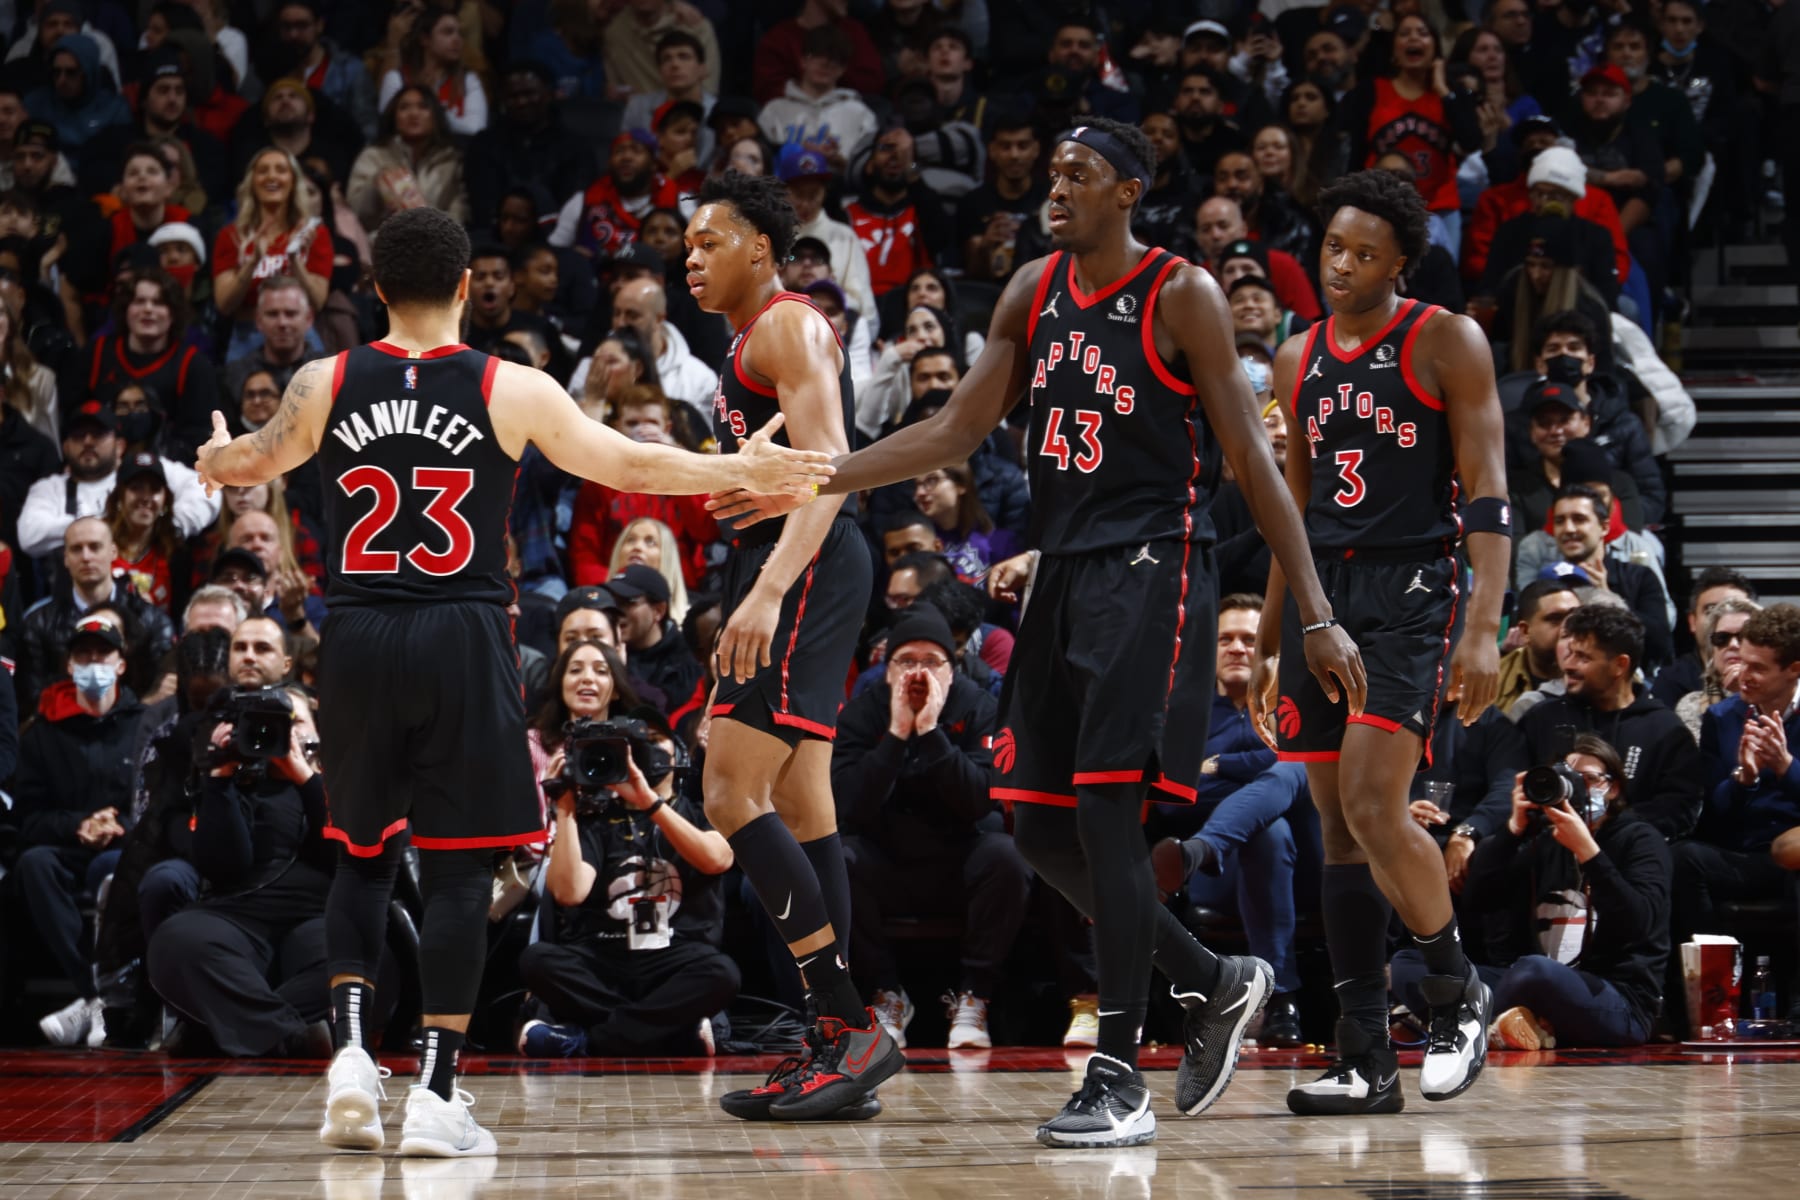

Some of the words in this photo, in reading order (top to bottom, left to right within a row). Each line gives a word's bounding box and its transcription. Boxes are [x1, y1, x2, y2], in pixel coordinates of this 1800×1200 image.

[1107, 312, 1123, 322] Sun
[1123, 315, 1138, 324] Life
[1030, 331, 1135, 415] APTORS
[332, 399, 485, 456] VANVLEET
[1040, 408, 1103, 473] 43
[1334, 449, 1366, 508] 3
[336, 465, 475, 577] 23
